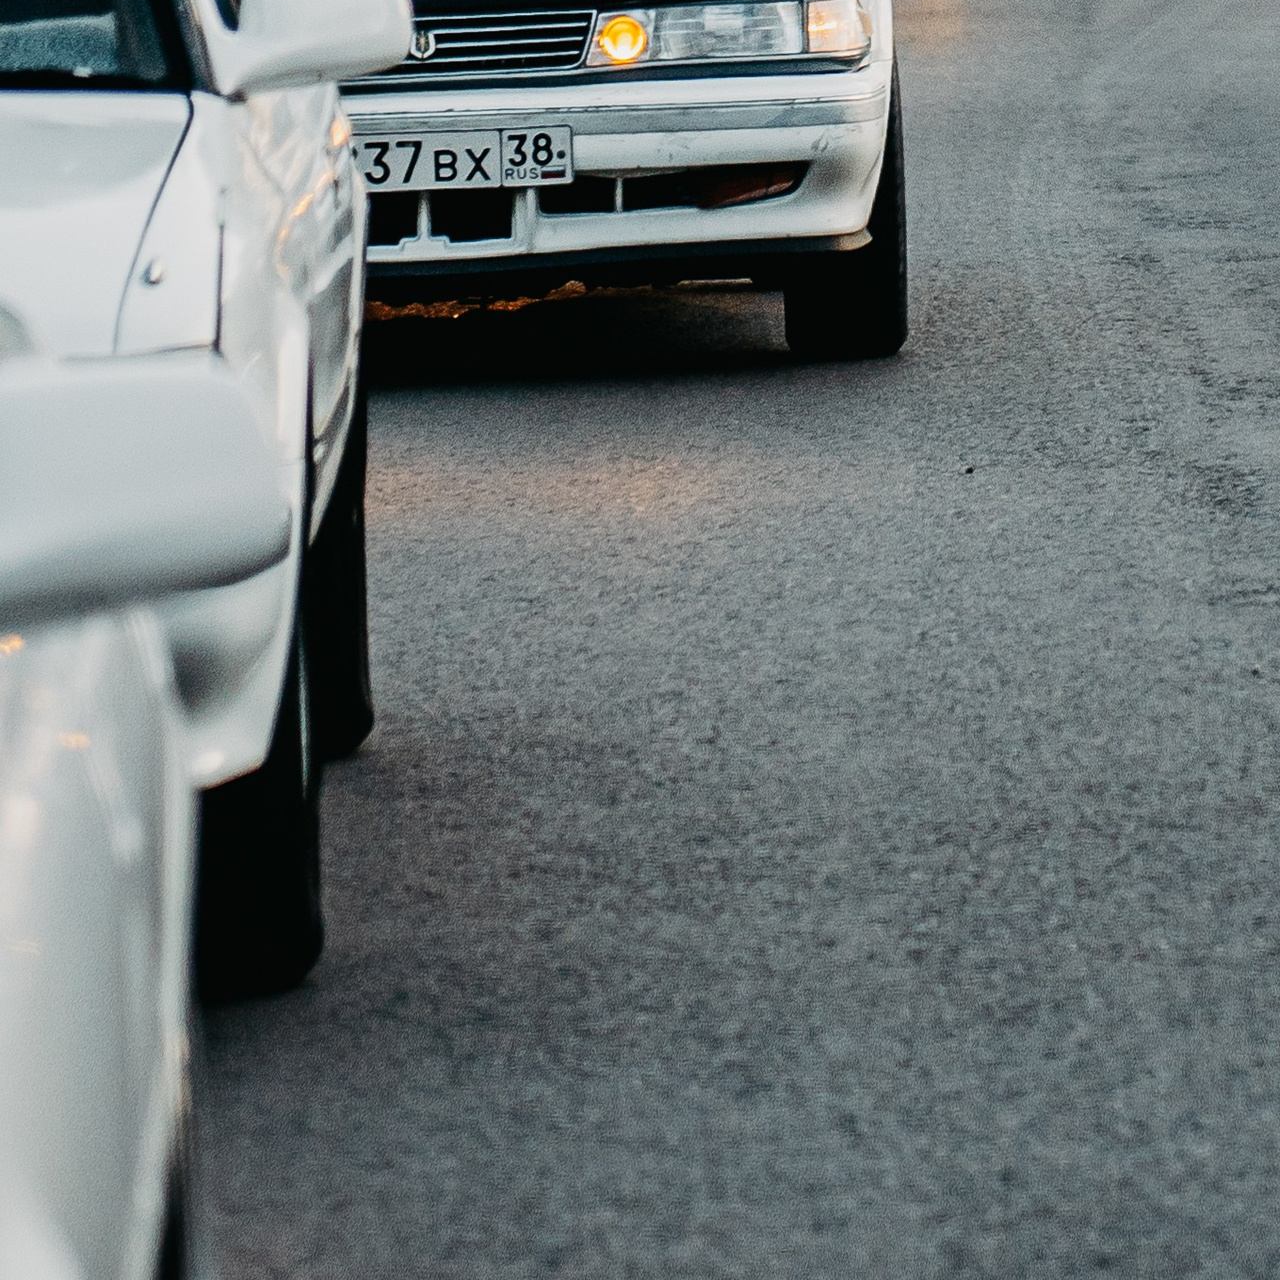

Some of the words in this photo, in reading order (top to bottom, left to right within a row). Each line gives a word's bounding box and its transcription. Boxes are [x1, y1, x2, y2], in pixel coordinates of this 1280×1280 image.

[352, 140, 423, 185] 37
[507, 132, 554, 167] 38
[504, 167, 539, 180] RUS
